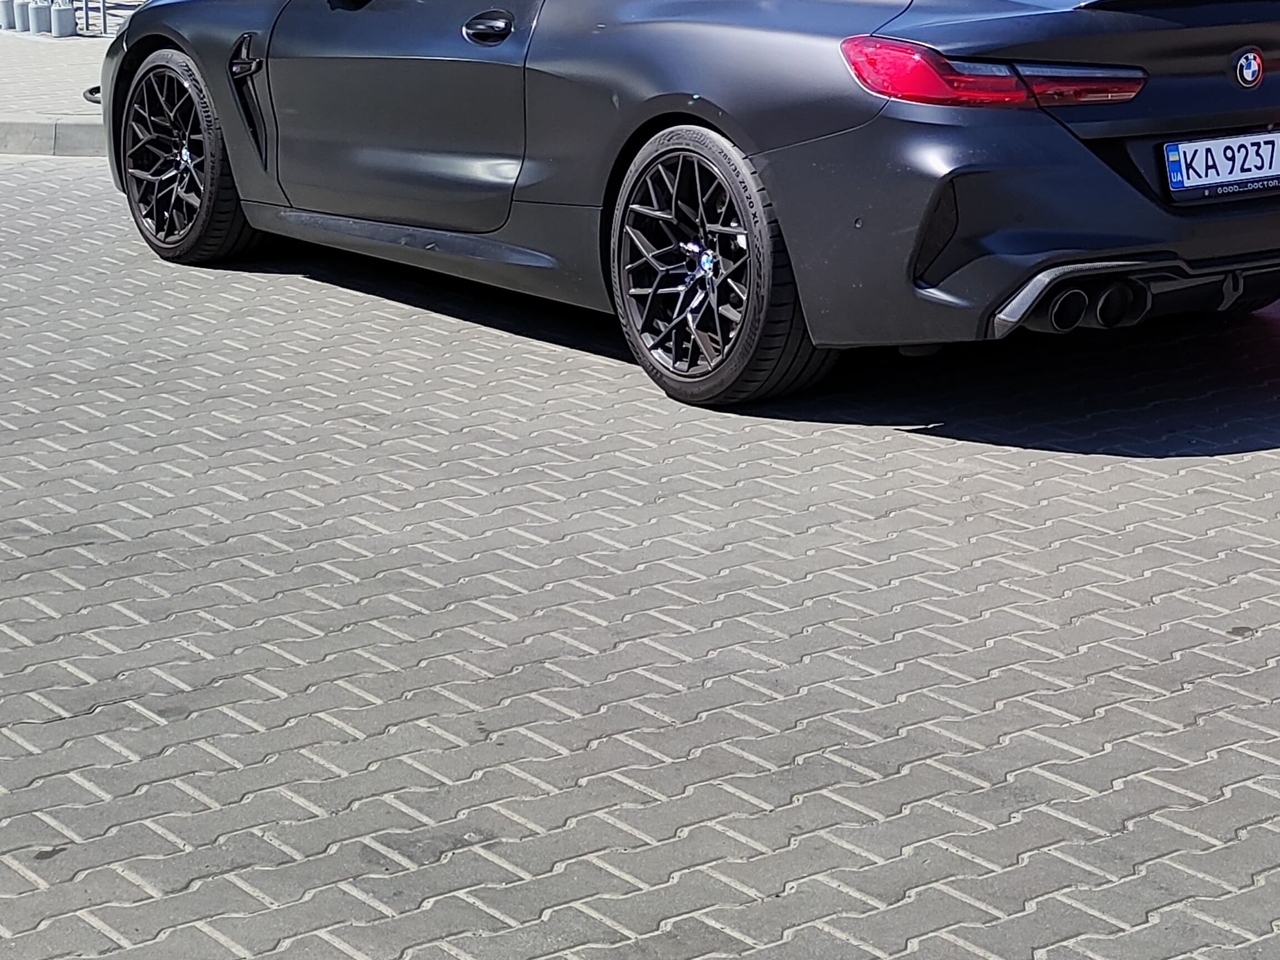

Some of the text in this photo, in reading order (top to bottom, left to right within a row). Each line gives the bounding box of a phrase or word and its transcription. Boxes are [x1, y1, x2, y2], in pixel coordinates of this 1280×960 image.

[1183, 147, 1220, 181] KA
[1223, 140, 1276, 176] 9237
[1171, 171, 1183, 182] UA
